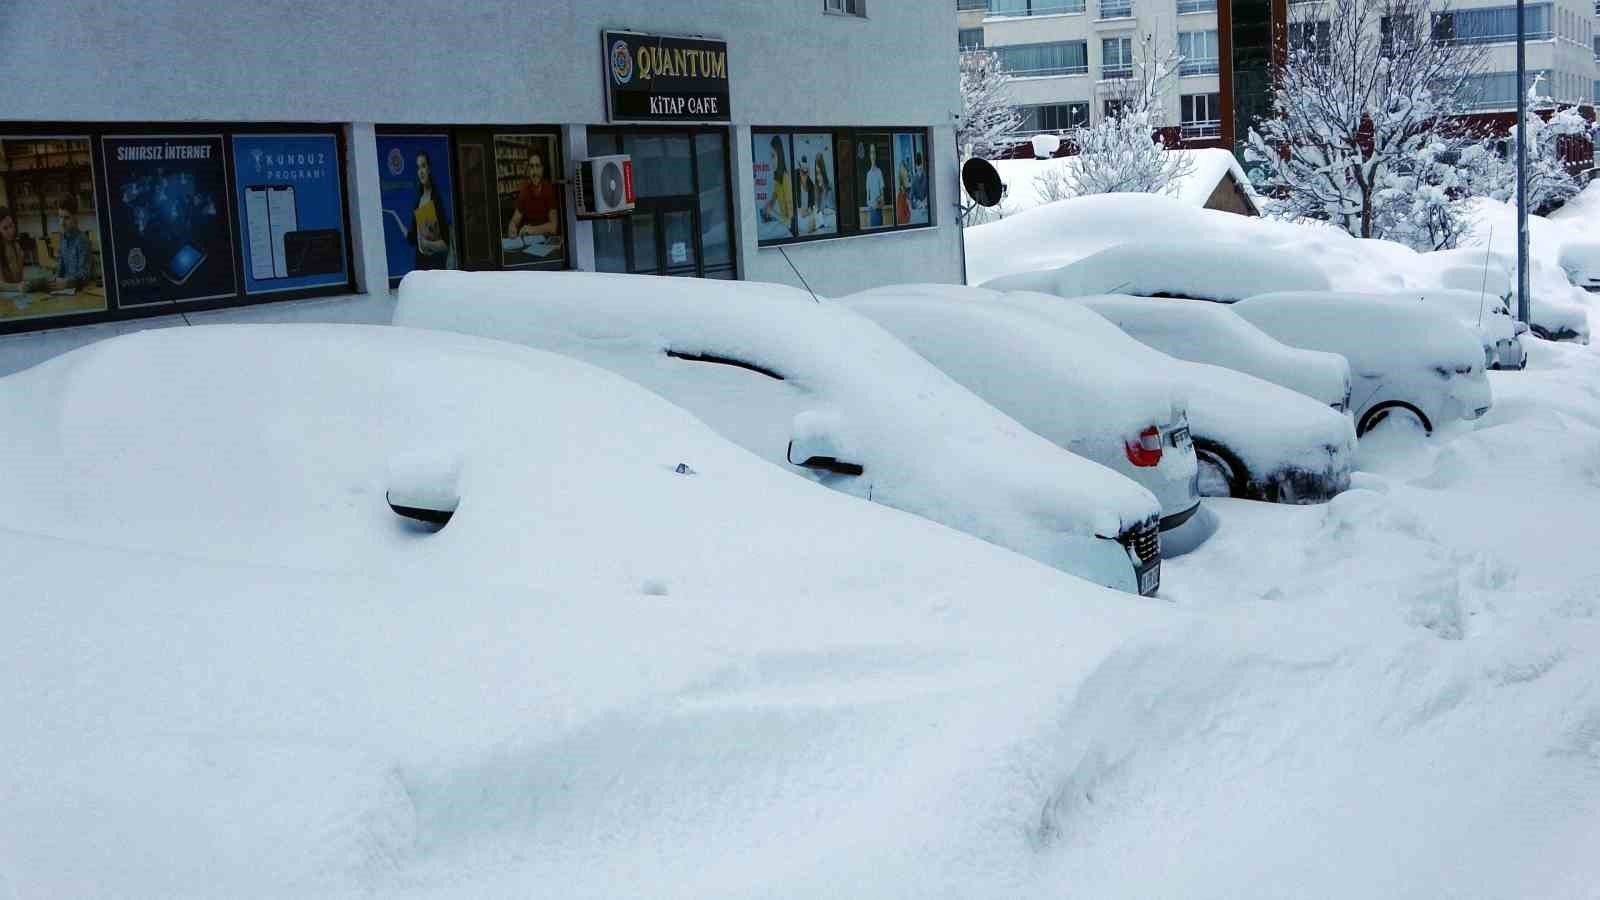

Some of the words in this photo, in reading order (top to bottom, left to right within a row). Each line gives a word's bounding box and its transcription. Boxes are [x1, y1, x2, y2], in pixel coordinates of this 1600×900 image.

[637, 46, 726, 79] QUANTUM
[688, 97, 718, 114] CAFE
[117, 146, 163, 161] SINIRSIZ
